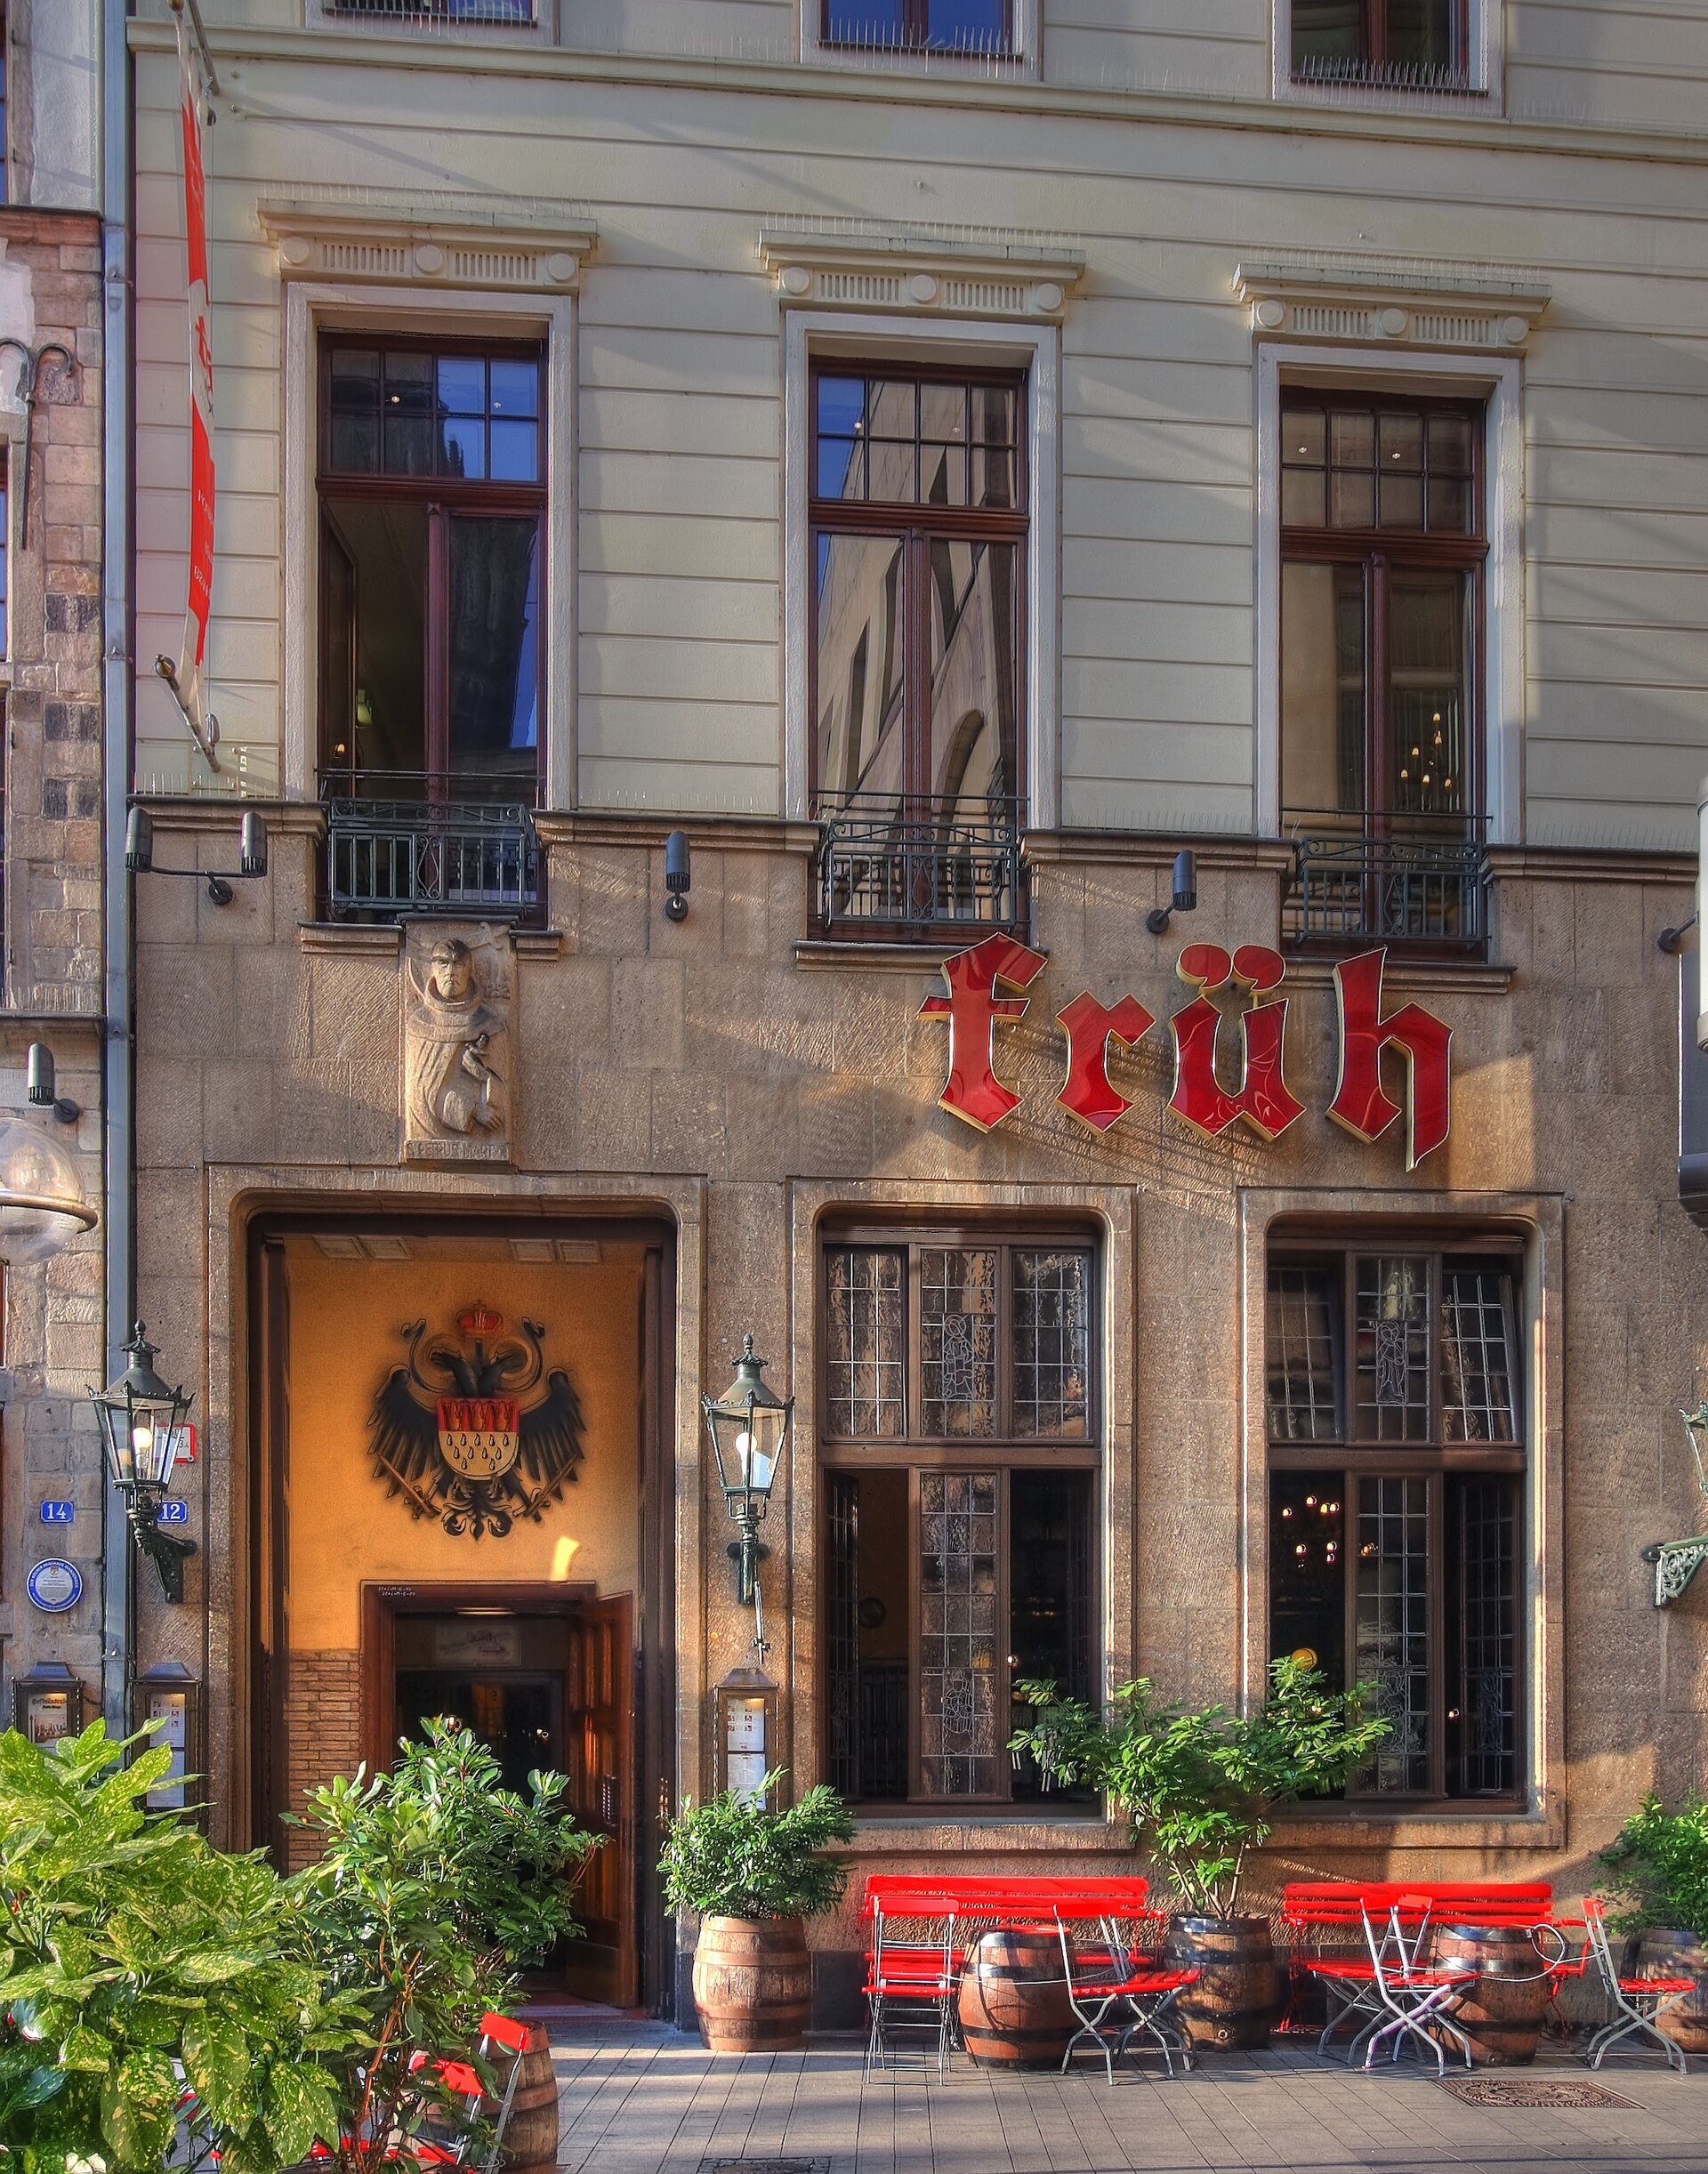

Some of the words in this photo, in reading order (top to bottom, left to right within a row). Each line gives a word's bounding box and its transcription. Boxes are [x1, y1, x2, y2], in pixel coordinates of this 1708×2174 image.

[917, 931, 1454, 1172] früh
[417, 1142, 460, 1157] PETRUS
[47, 1503, 67, 1519] 14
[162, 1503, 181, 1520] 12
